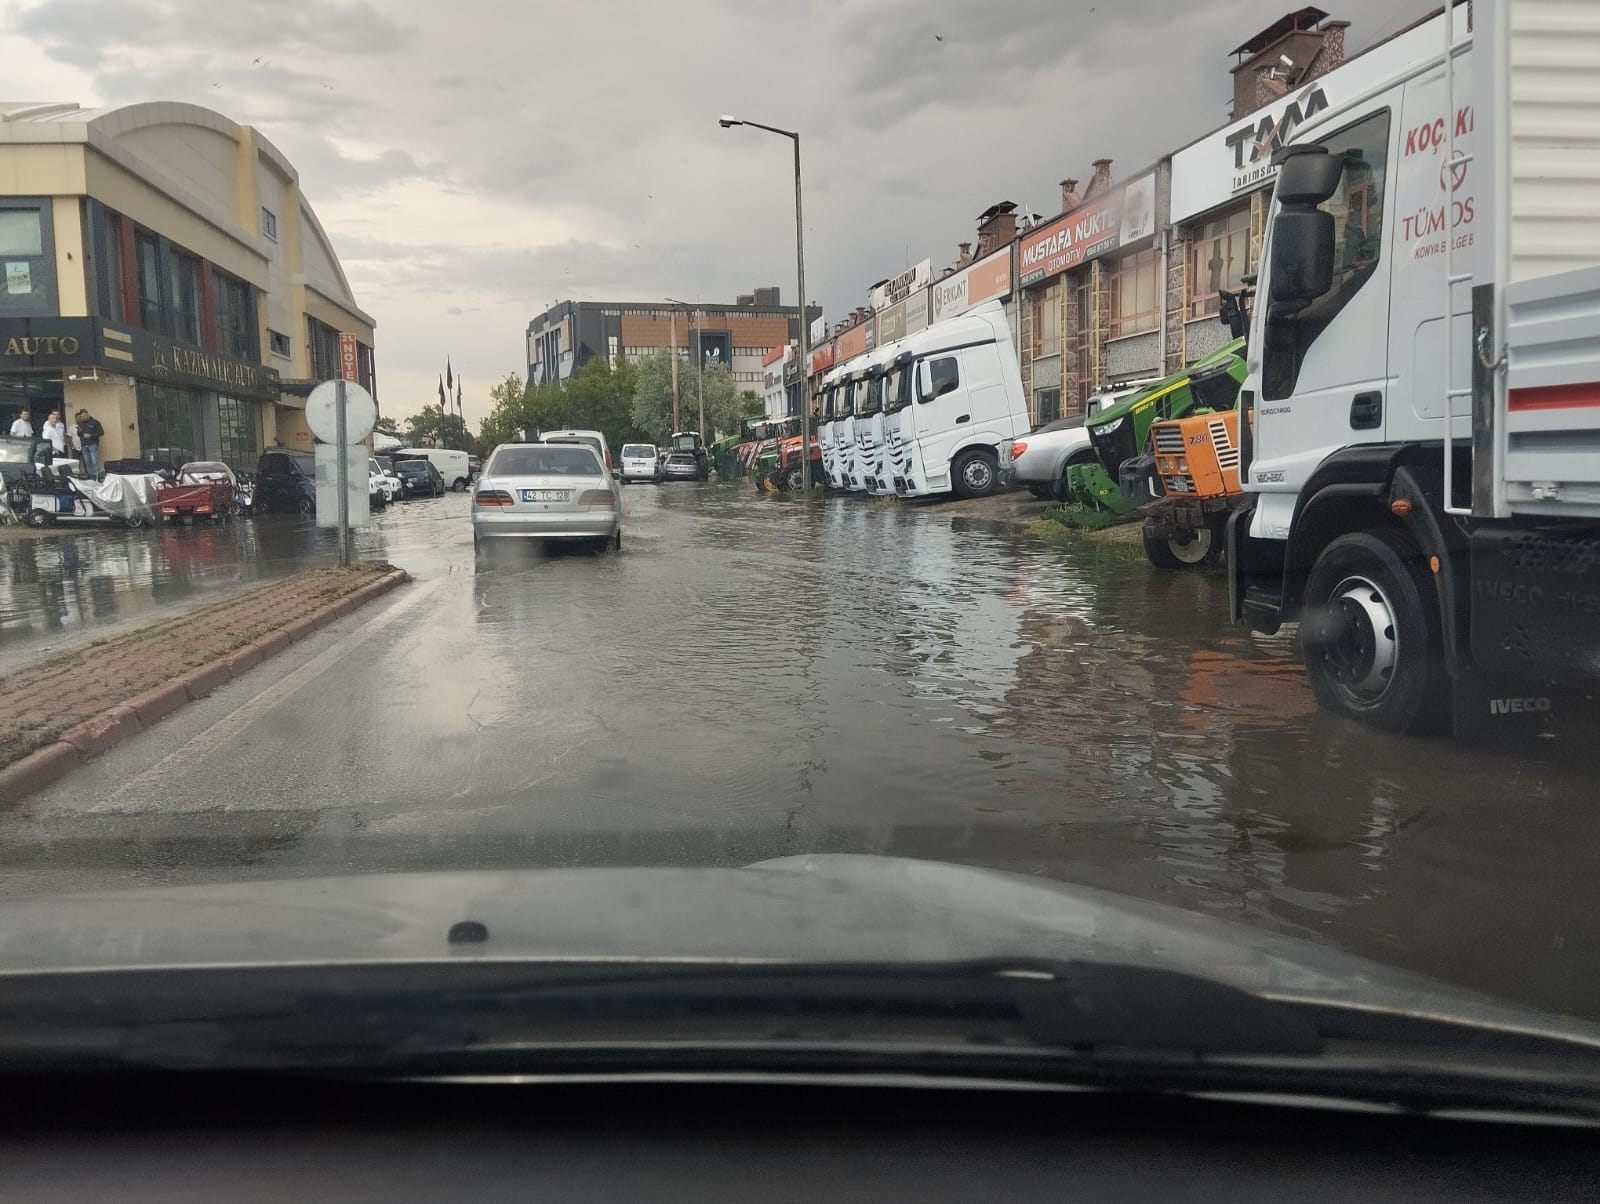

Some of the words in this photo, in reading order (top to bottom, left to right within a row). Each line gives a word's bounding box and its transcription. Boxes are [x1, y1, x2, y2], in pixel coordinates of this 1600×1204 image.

[1022, 226, 1072, 268] MUSTAFA
[1415, 242, 1439, 260] KONYA
[1441, 233, 1467, 254] BLGE
[943, 280, 967, 306] ERKUNT
[4, 336, 80, 355] AUTO
[235, 364, 258, 387] AUTO
[527, 490, 537, 500] 42
[541, 490, 553, 500] TC
[1490, 697, 1551, 714] IVECO
